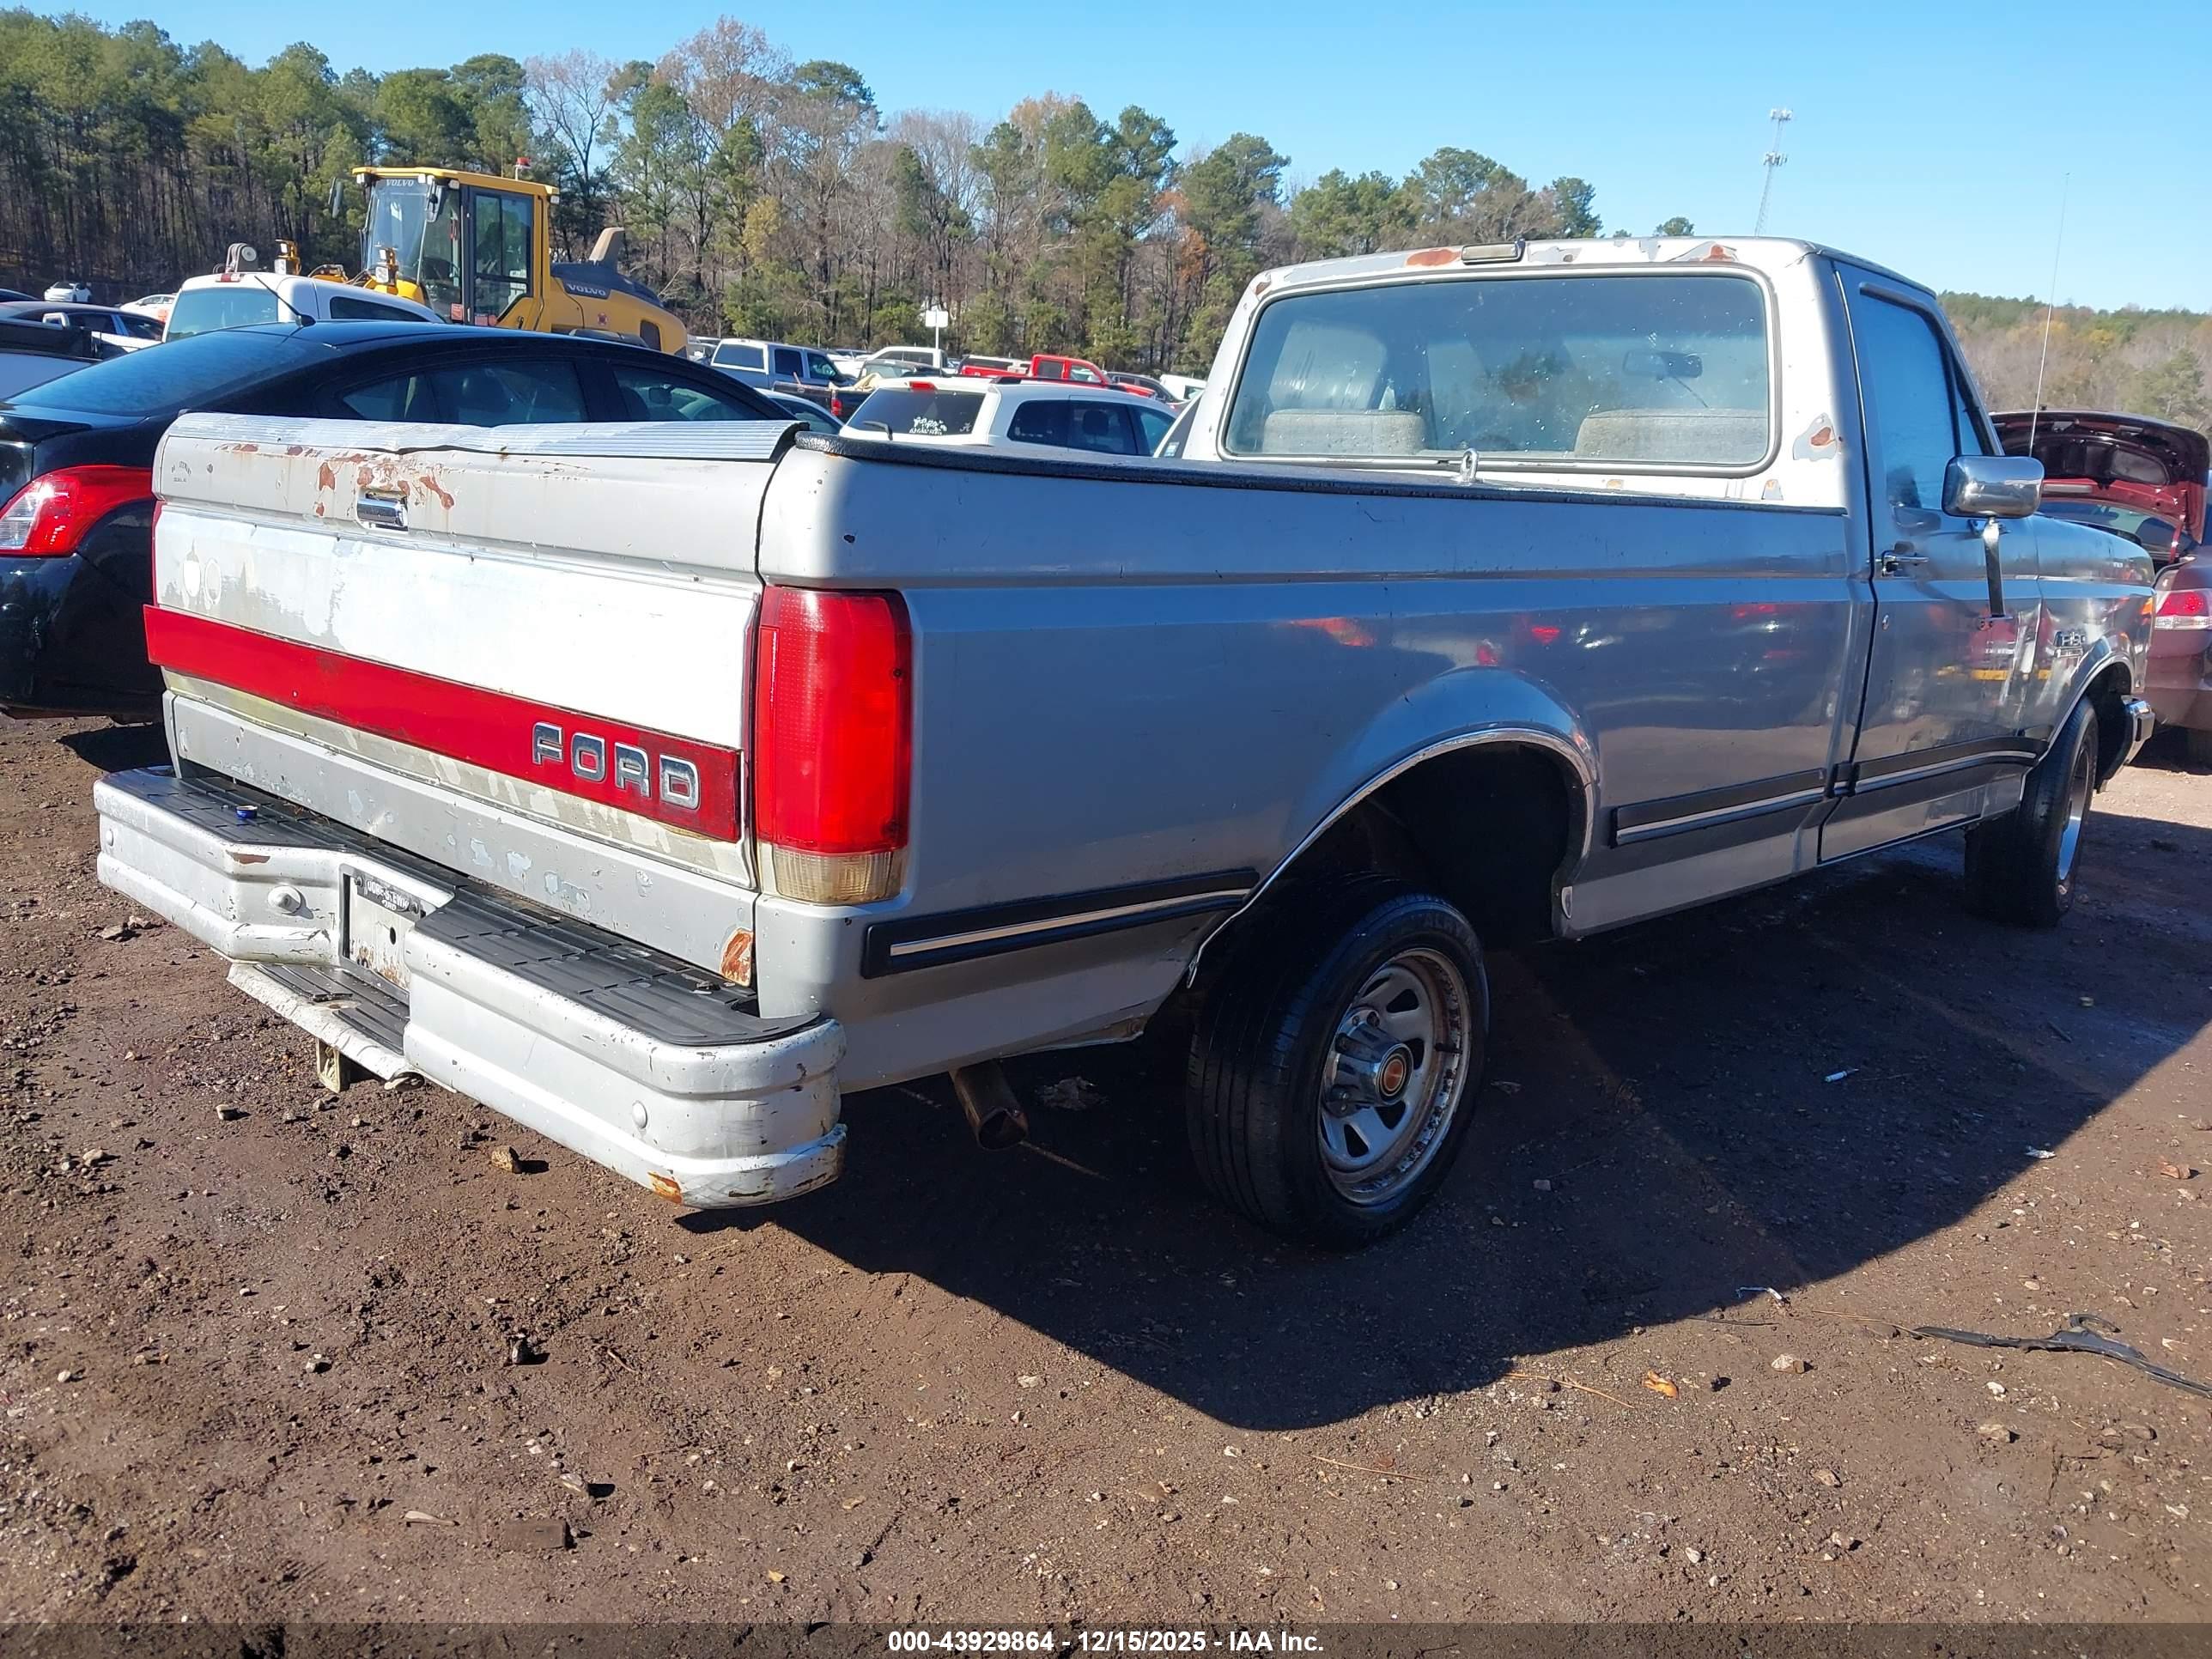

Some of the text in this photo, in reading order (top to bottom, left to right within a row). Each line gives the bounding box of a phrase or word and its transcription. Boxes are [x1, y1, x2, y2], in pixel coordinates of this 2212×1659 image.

[386, 179, 414, 187] VOLVO
[566, 283, 607, 297] VOLVO
[532, 721, 701, 810] FORD
